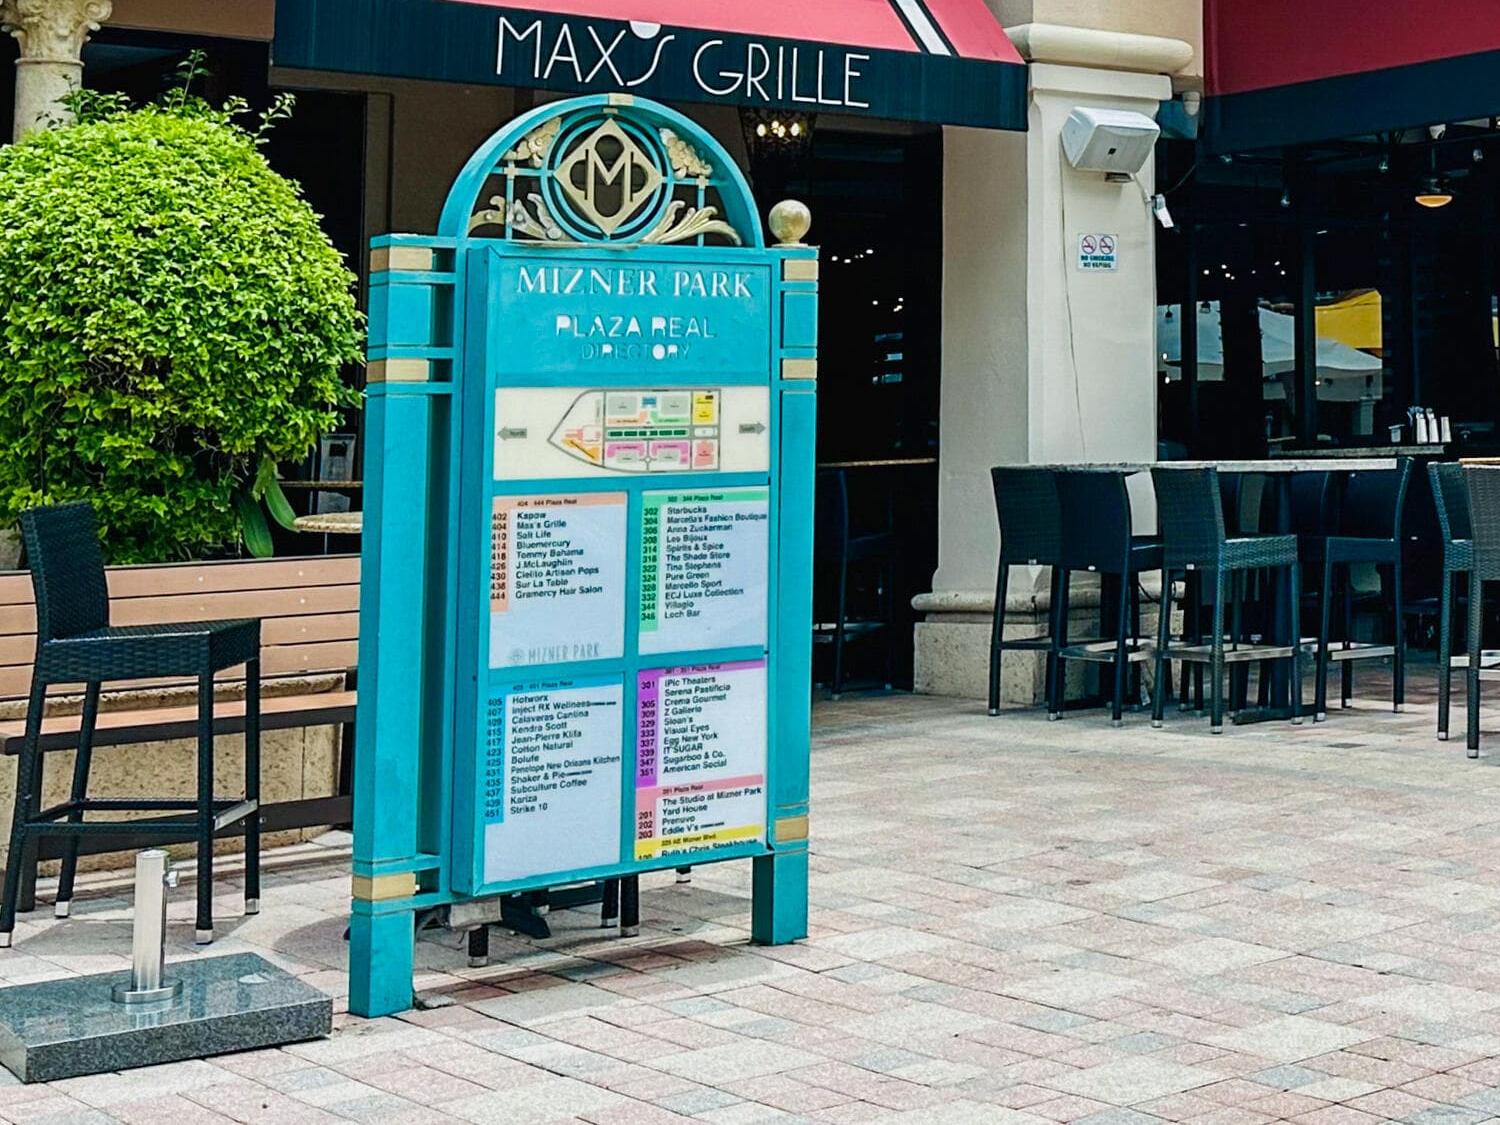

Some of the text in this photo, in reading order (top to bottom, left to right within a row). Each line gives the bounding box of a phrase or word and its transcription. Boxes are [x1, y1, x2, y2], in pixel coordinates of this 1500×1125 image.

[692, 39, 871, 108] GRILLE
[517, 266, 755, 299] MIZNER PARK
[555, 315, 717, 339] PLAZA REAL
[667, 507, 707, 515] Starbucks
[517, 512, 546, 521] Kapow
[543, 520, 567, 528] Grille
[535, 531, 551, 539] Life
[517, 540, 571, 551] Bluemercury
[694, 543, 700, 551] &
[702, 542, 724, 552] Spice
[517, 551, 547, 560] Tommy
[550, 549, 584, 557] Bahama
[666, 554, 681, 562] The
[709, 551, 731, 559] Store
[545, 569, 576, 577] Artisan
[578, 567, 600, 576] Pops
[666, 572, 710, 581] Pure Green
[516, 579, 568, 589] Sur La Table
[701, 580, 722, 589] Sport
[516, 591, 557, 599] Gramercy
[560, 588, 577, 596] Hair
[578, 586, 603, 595] Salon
[665, 591, 681, 600] ECJ
[664, 610, 684, 619] Loch
[686, 609, 701, 618] Bar
[528, 642, 600, 664] MIZNER PARK
[682, 676, 716, 685] Theaters
[664, 688, 692, 697] Serena
[512, 695, 548, 704] Hotworx
[664, 698, 690, 706] Crema
[692, 694, 727, 703] Gourmet
[512, 705, 536, 715] Inject
[664, 708, 670, 716] Z
[512, 715, 554, 724] Calaveras
[512, 725, 543, 734] Kendra
[545, 722, 567, 731] Scott
[664, 726, 688, 735] Visual
[690, 724, 710, 734] Eyes
[664, 736, 680, 746] Egg
[701, 732, 719, 740] York
[543, 741, 573, 751] Natural
[663, 763, 701, 774] American
[703, 759, 728, 769] Social
[511, 774, 541, 784] Shaker
[510, 783, 557, 794] Subculture
[560, 779, 587, 788] Coffee
[662, 798, 678, 806] The
[680, 794, 705, 804] Studio
[744, 786, 762, 795] Park
[510, 805, 535, 815] Strike
[539, 802, 548, 811] 10
[638, 803, 708, 820] 201 Yard House
[638, 821, 653, 829] 202
[662, 826, 684, 835] Eddie
